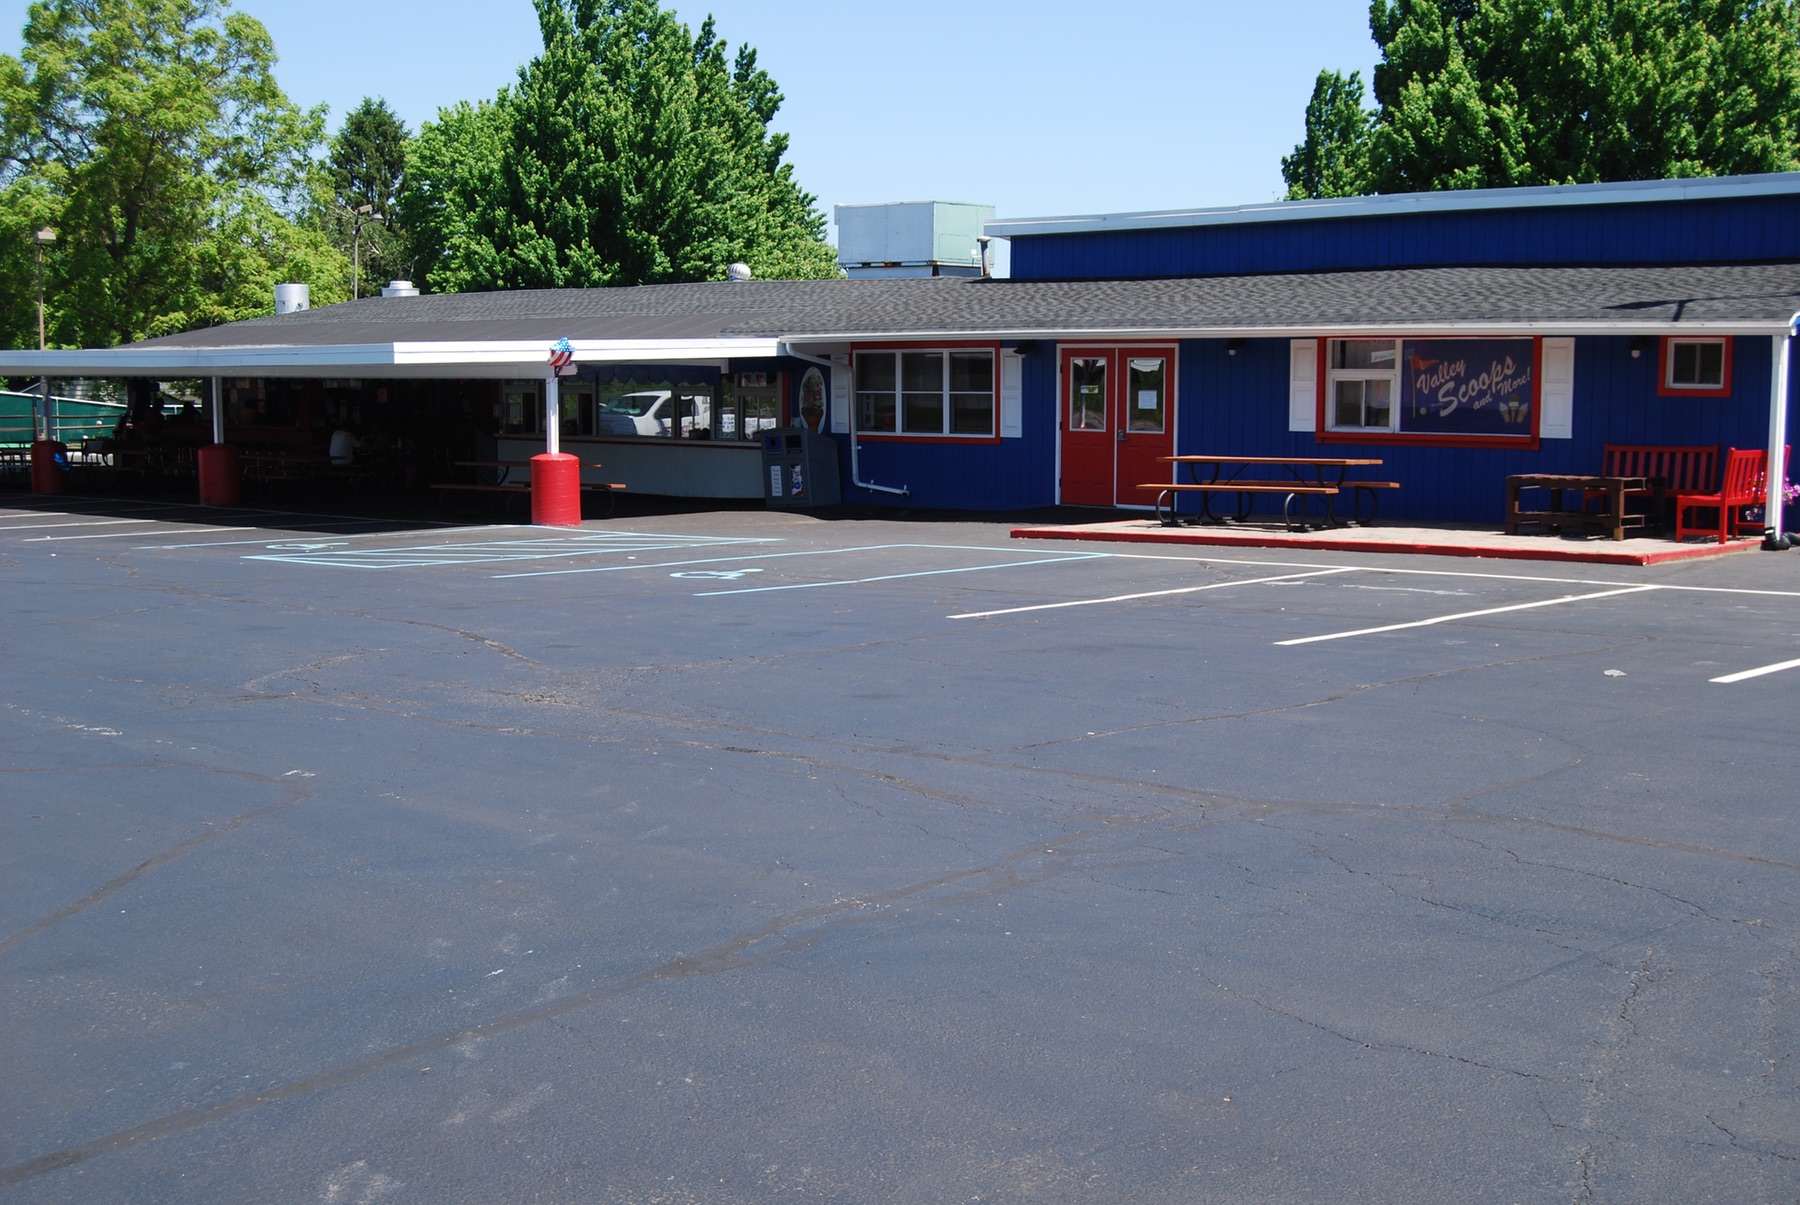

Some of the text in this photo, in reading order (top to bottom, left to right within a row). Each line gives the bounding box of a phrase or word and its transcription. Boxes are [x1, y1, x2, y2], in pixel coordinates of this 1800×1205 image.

[1416, 359, 1466, 394] Valley
[1438, 356, 1516, 417] Scoops
[1473, 366, 1531, 410] and More!
